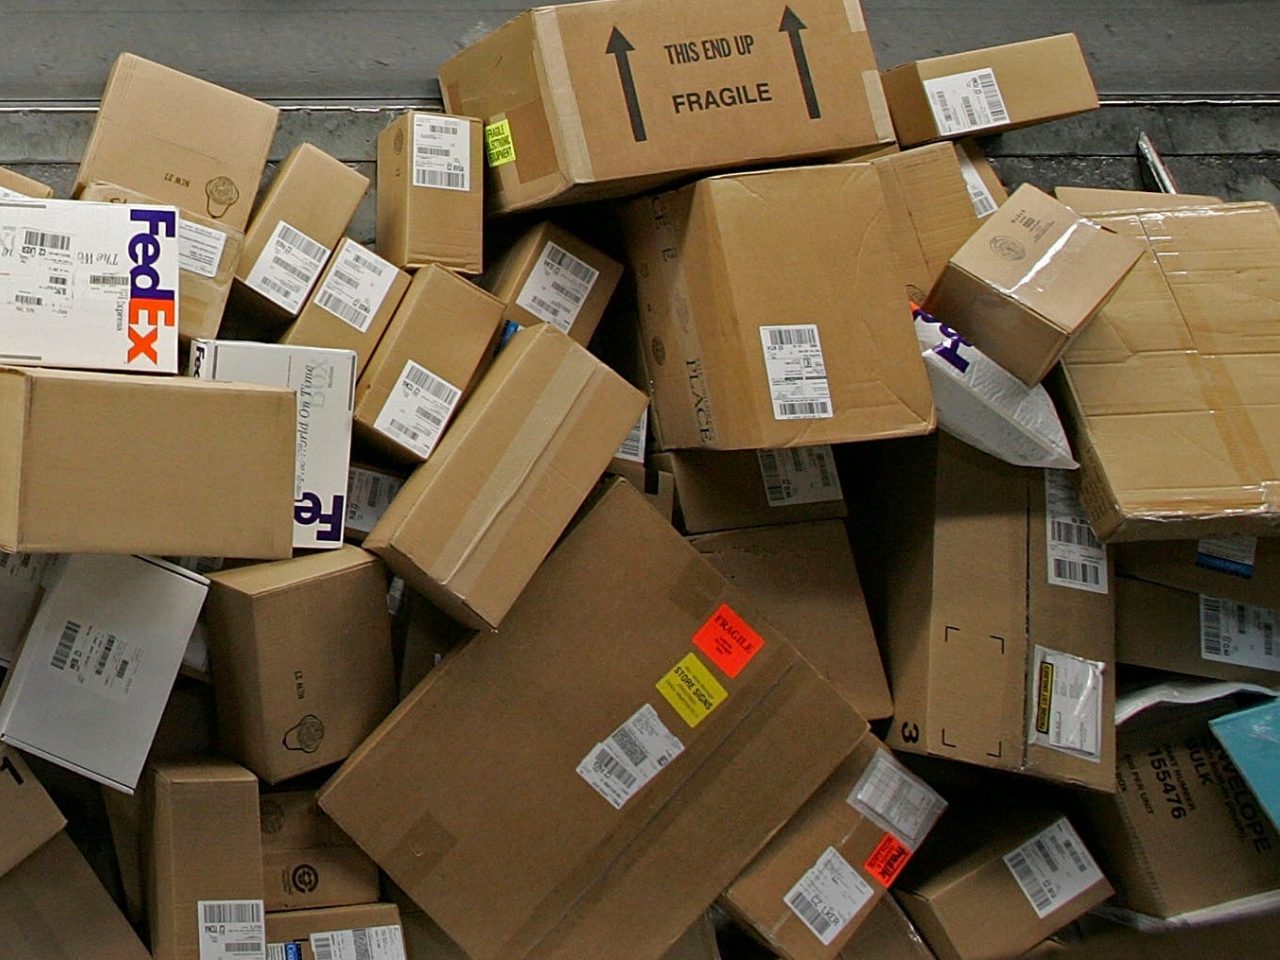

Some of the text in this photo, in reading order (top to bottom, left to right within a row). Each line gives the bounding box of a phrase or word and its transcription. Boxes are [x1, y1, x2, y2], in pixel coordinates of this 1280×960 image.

[663, 34, 755, 66] THIS END UP
[671, 82, 773, 115] FRAGILE
[102, 250, 120, 268] The
[128, 209, 176, 366] FedEx
[302, 364, 315, 399] Time
[685, 359, 713, 445] PLACE
[713, 613, 754, 656] FRAGILE
[673, 665, 699, 693] STORE
[691, 685, 714, 713] SIGNS
[900, 720, 919, 744] 3
[0, 756, 24, 786] 1
[1147, 748, 1187, 820] 155476
[809, 894, 823, 908] CZ
